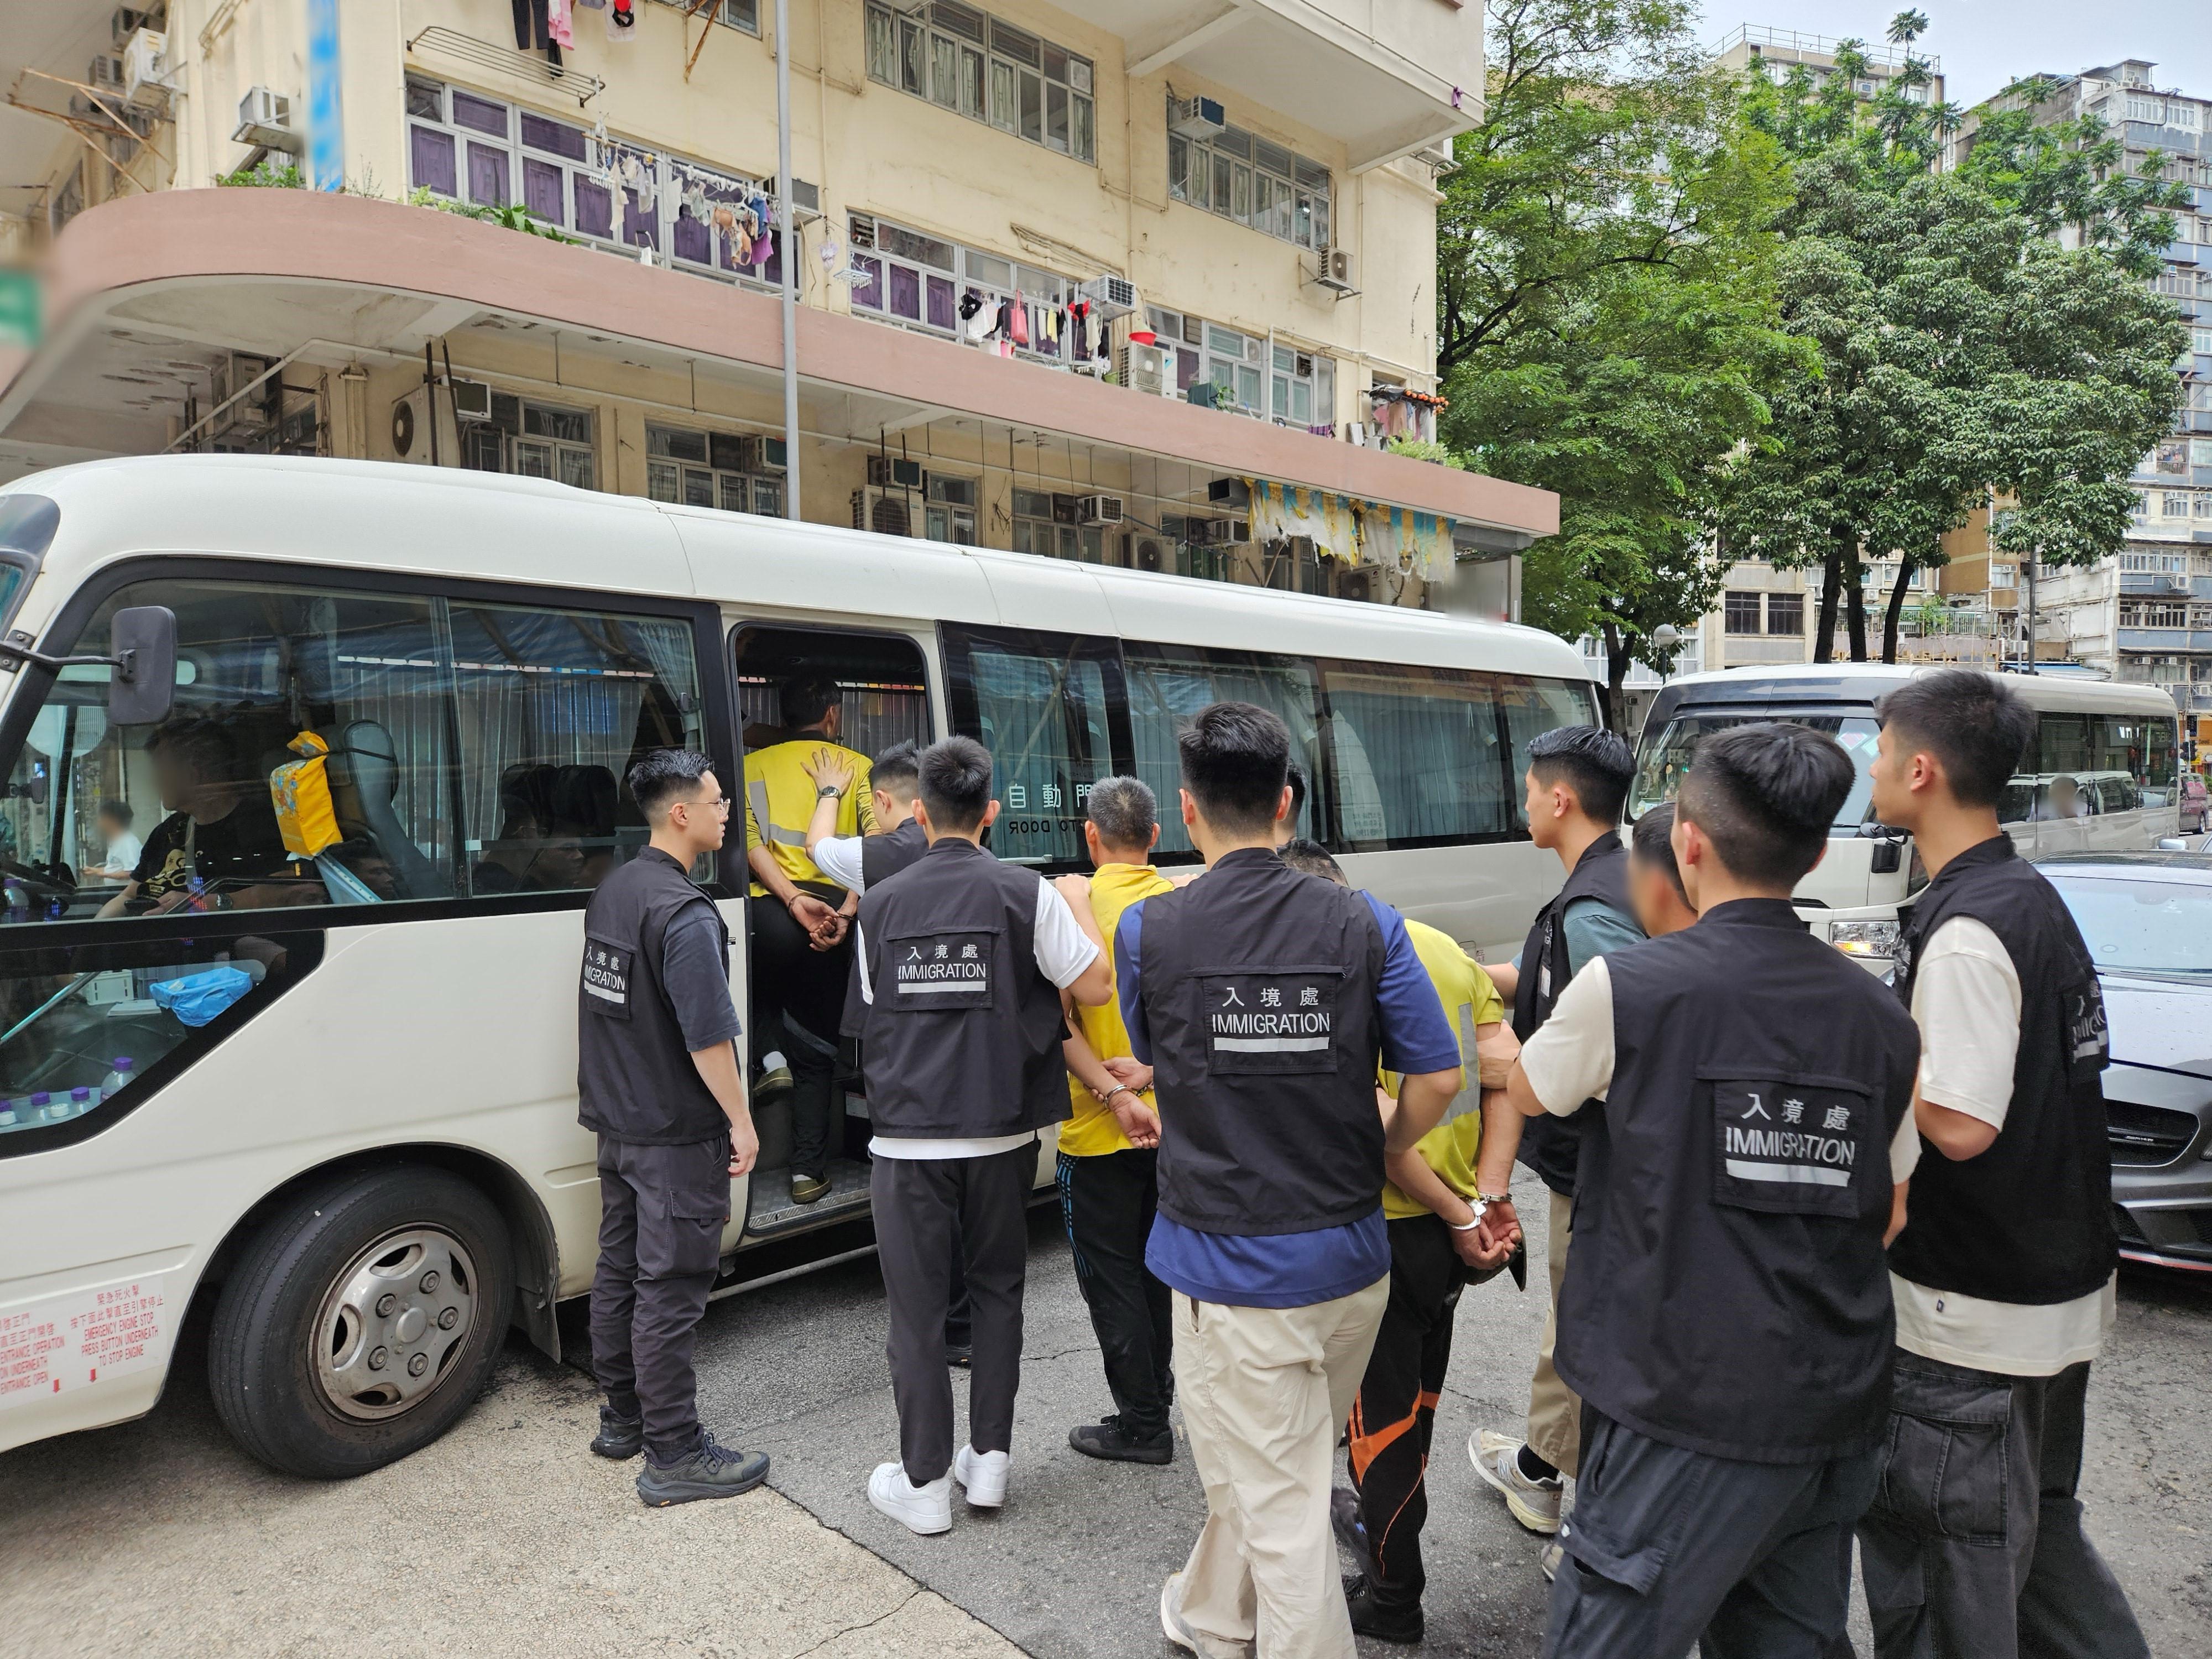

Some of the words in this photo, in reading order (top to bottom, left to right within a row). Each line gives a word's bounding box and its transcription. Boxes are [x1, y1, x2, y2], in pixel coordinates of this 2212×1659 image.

[1009, 784, 1093, 808] 自動門
[586, 946, 619, 971] 入境處
[907, 944, 978, 961] 入境處
[898, 963, 986, 979] IMMIGRATION
[1222, 987, 1319, 1007] 入境處
[1212, 1013, 1330, 1034] IMMIGRATION
[1741, 1093, 1850, 1131] 入境處
[1726, 1126, 1855, 1165] IMMIGRATION
[84, 1321, 116, 1341] EMERGENCY
[119, 1316, 138, 1332] ENGINE
[139, 1312, 154, 1326] STOP
[81, 1342, 99, 1357] PRESS
[101, 1335, 123, 1352] BUTTON
[124, 1324, 159, 1344] UNDERNEATH
[99, 1355, 106, 1366] TO
[108, 1350, 123, 1364] STOP
[125, 1344, 144, 1360] ENGINE
